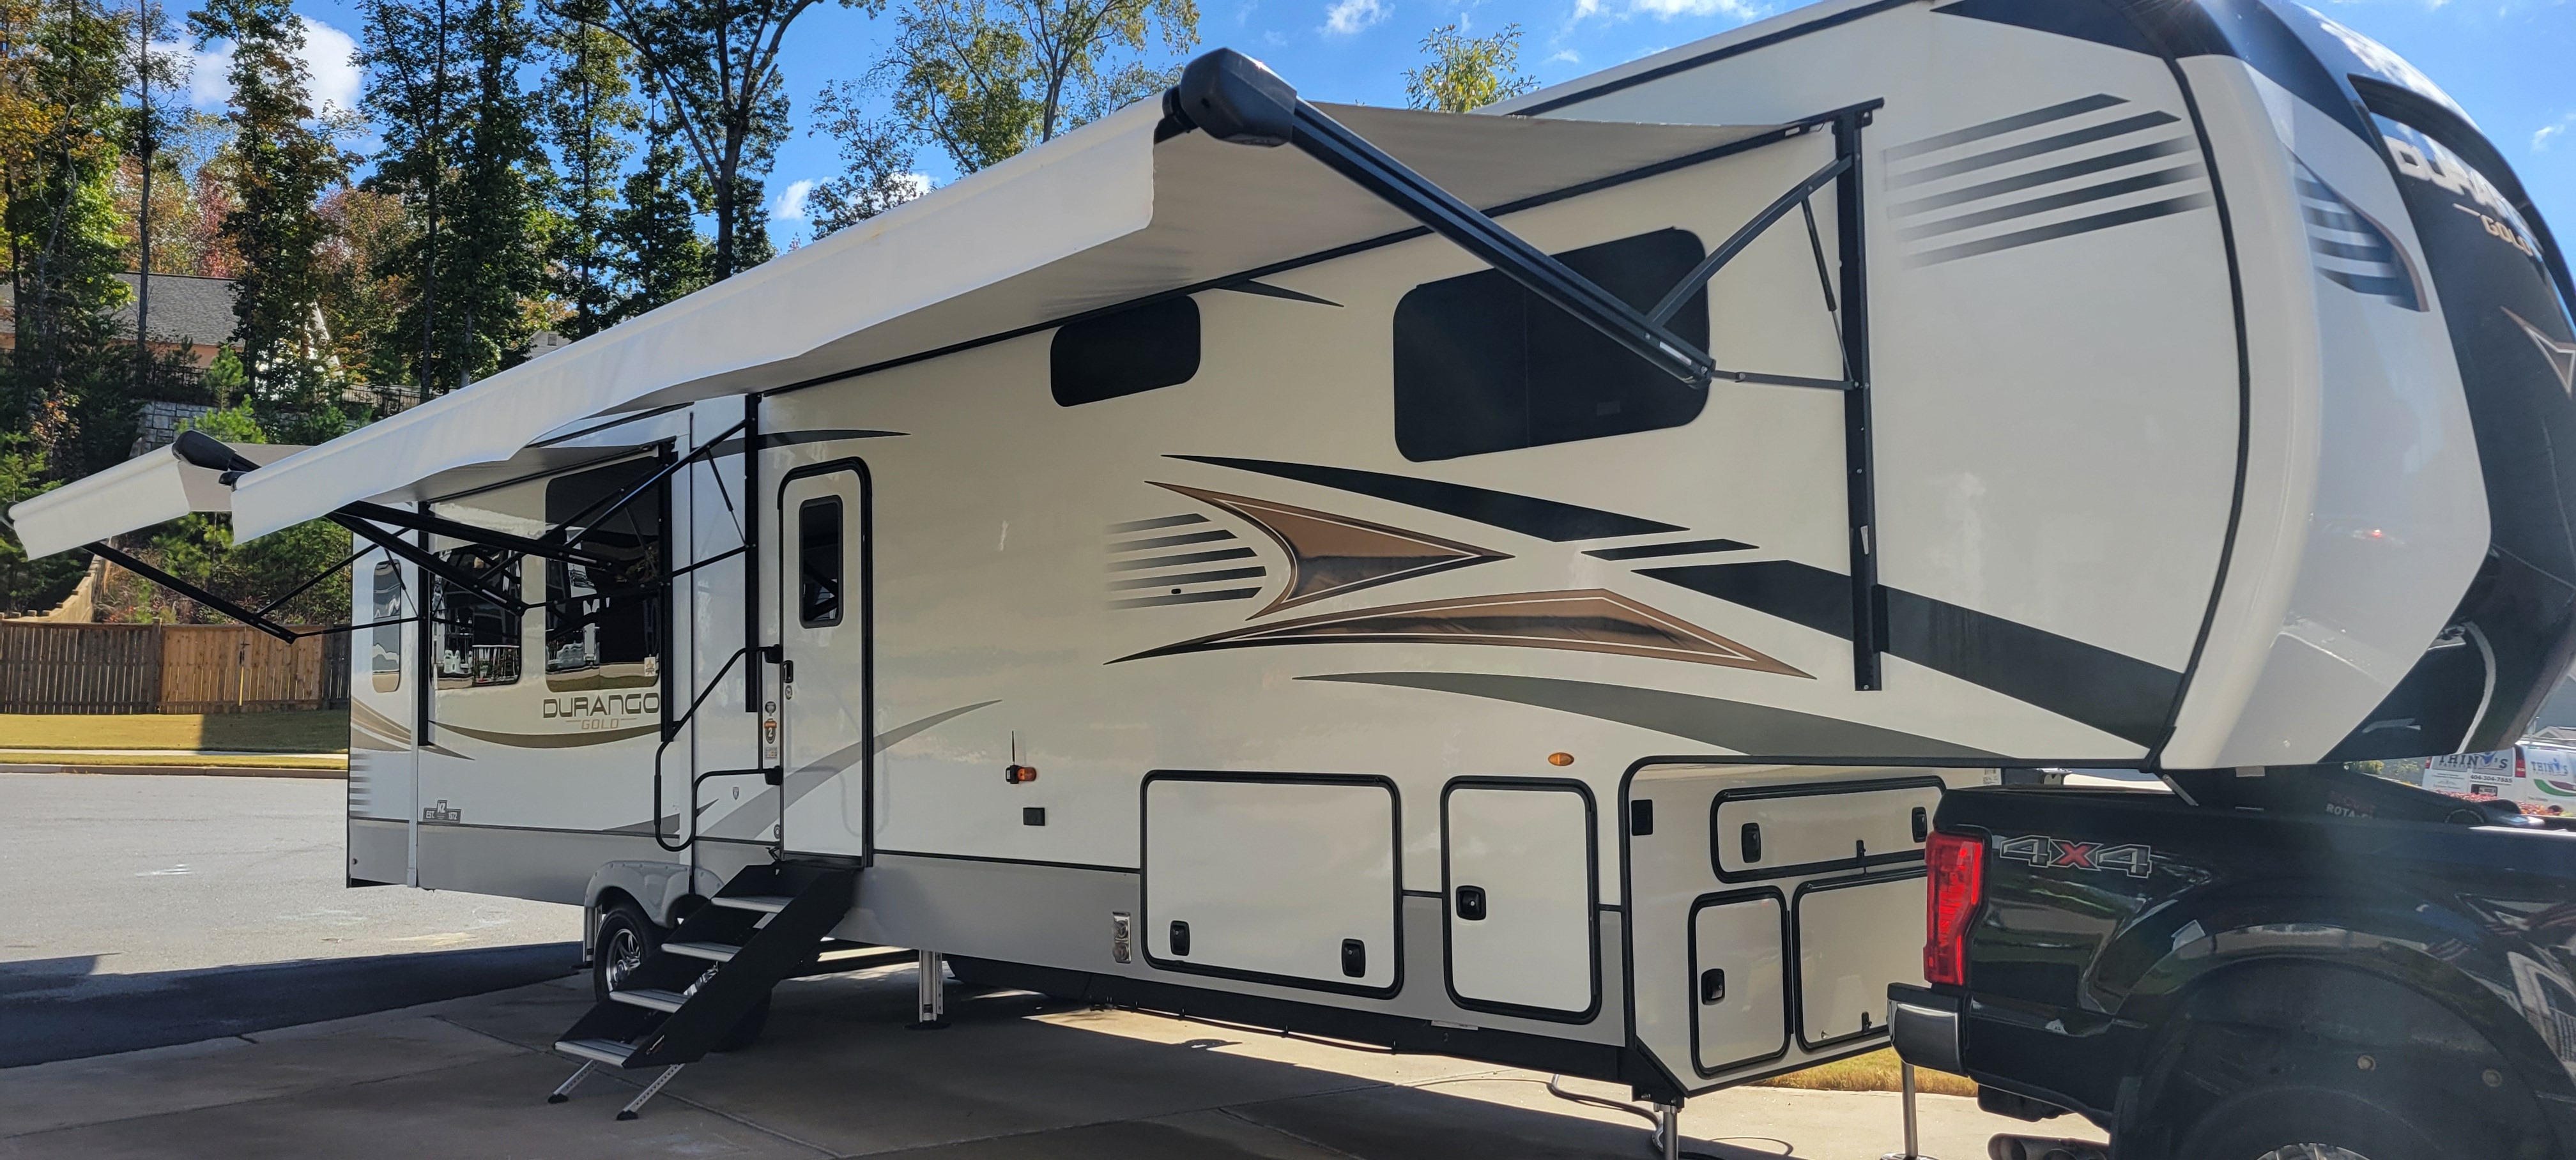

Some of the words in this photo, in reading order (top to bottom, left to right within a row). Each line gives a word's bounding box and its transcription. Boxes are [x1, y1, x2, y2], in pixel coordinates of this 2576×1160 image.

[2481, 214, 2533, 257] GOLD
[543, 692, 660, 718] DURANGO
[581, 718, 619, 729] GOLD
[768, 727, 773, 737] 2
[437, 802, 446, 813] KZ
[448, 812, 457, 820] 1972
